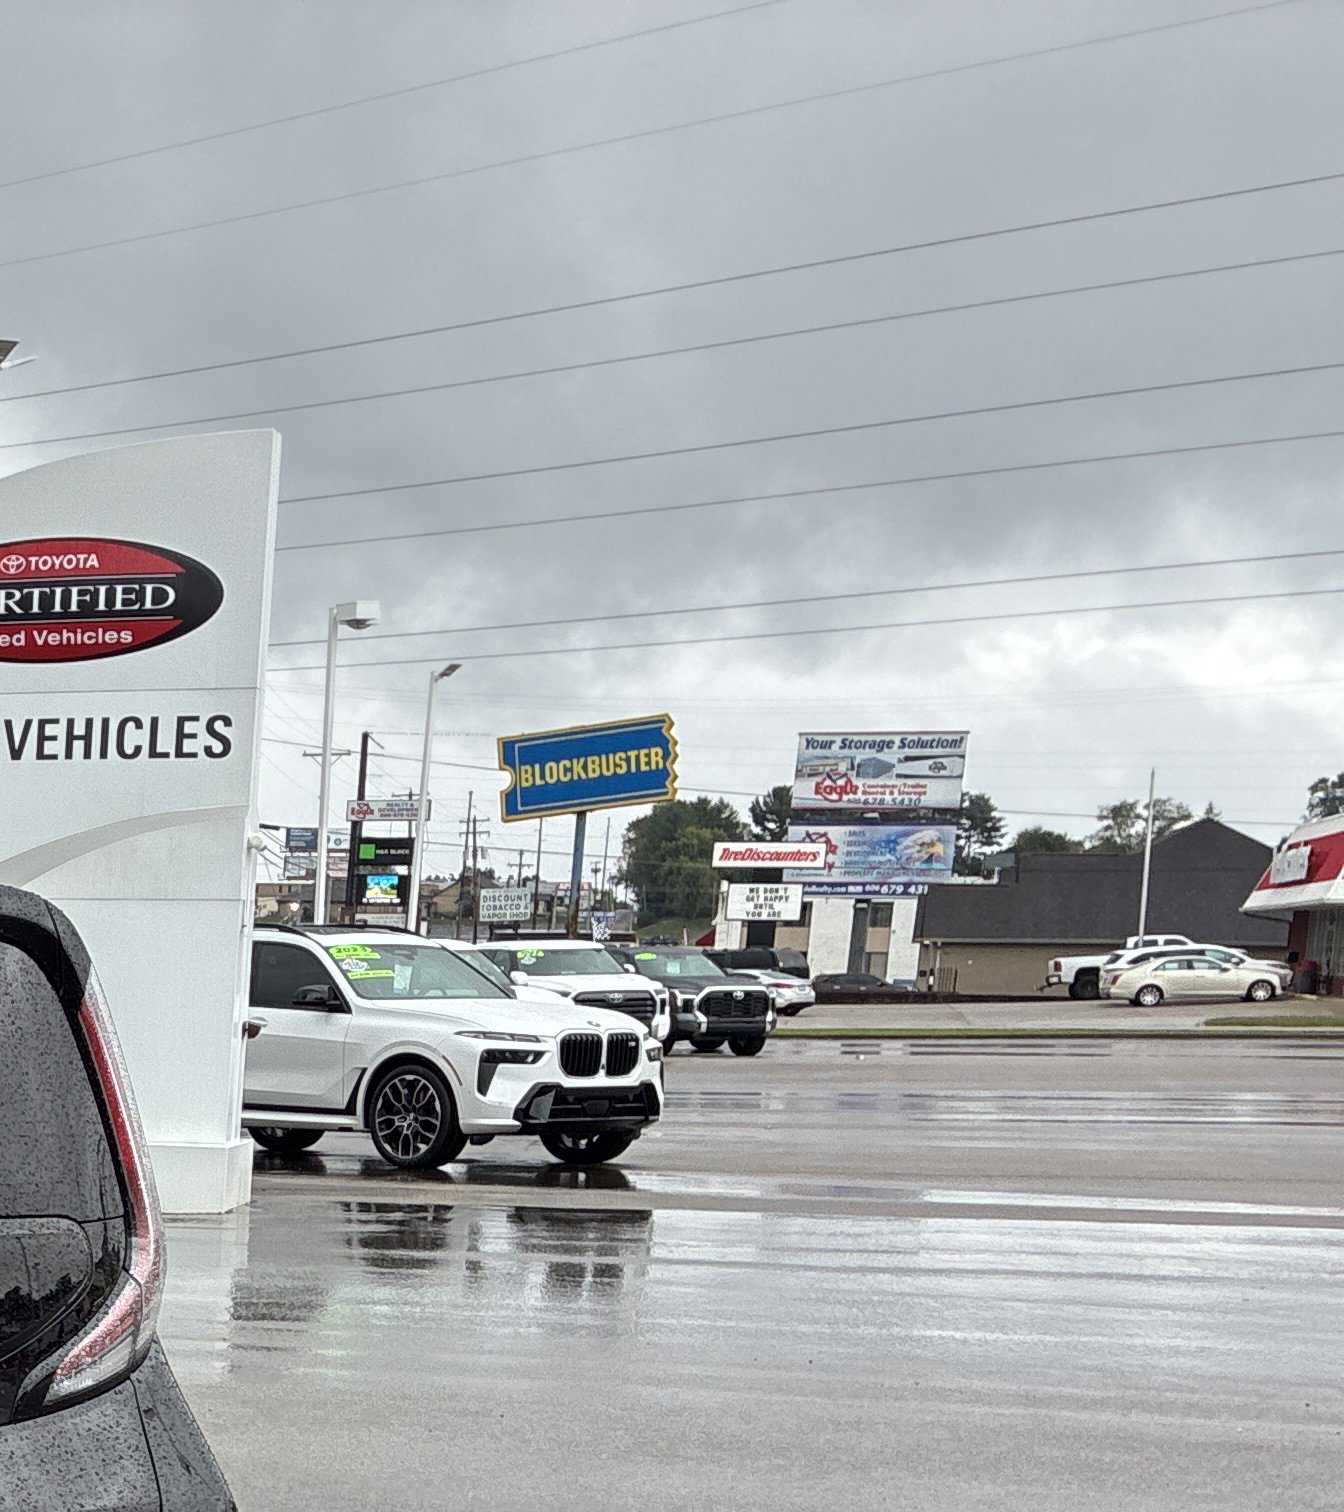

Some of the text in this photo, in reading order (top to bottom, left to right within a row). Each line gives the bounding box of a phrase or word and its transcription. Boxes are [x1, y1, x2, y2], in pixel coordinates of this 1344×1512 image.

[28, 553, 100, 571] TOYOTA
[32, 627, 133, 646] Vehicles
[3, 714, 233, 761] VEHICLES
[805, 736, 965, 753] Your Storage Solution!
[520, 746, 664, 788] BLOCKBUSTER
[814, 779, 859, 801] Eagle
[719, 848, 821, 862] TireDiscounters
[880, 884, 904, 894] 679
[482, 893, 528, 903] DISCOUNT
[481, 903, 521, 912] TOBACCO
[481, 911, 528, 920] VAPOR SHOP
